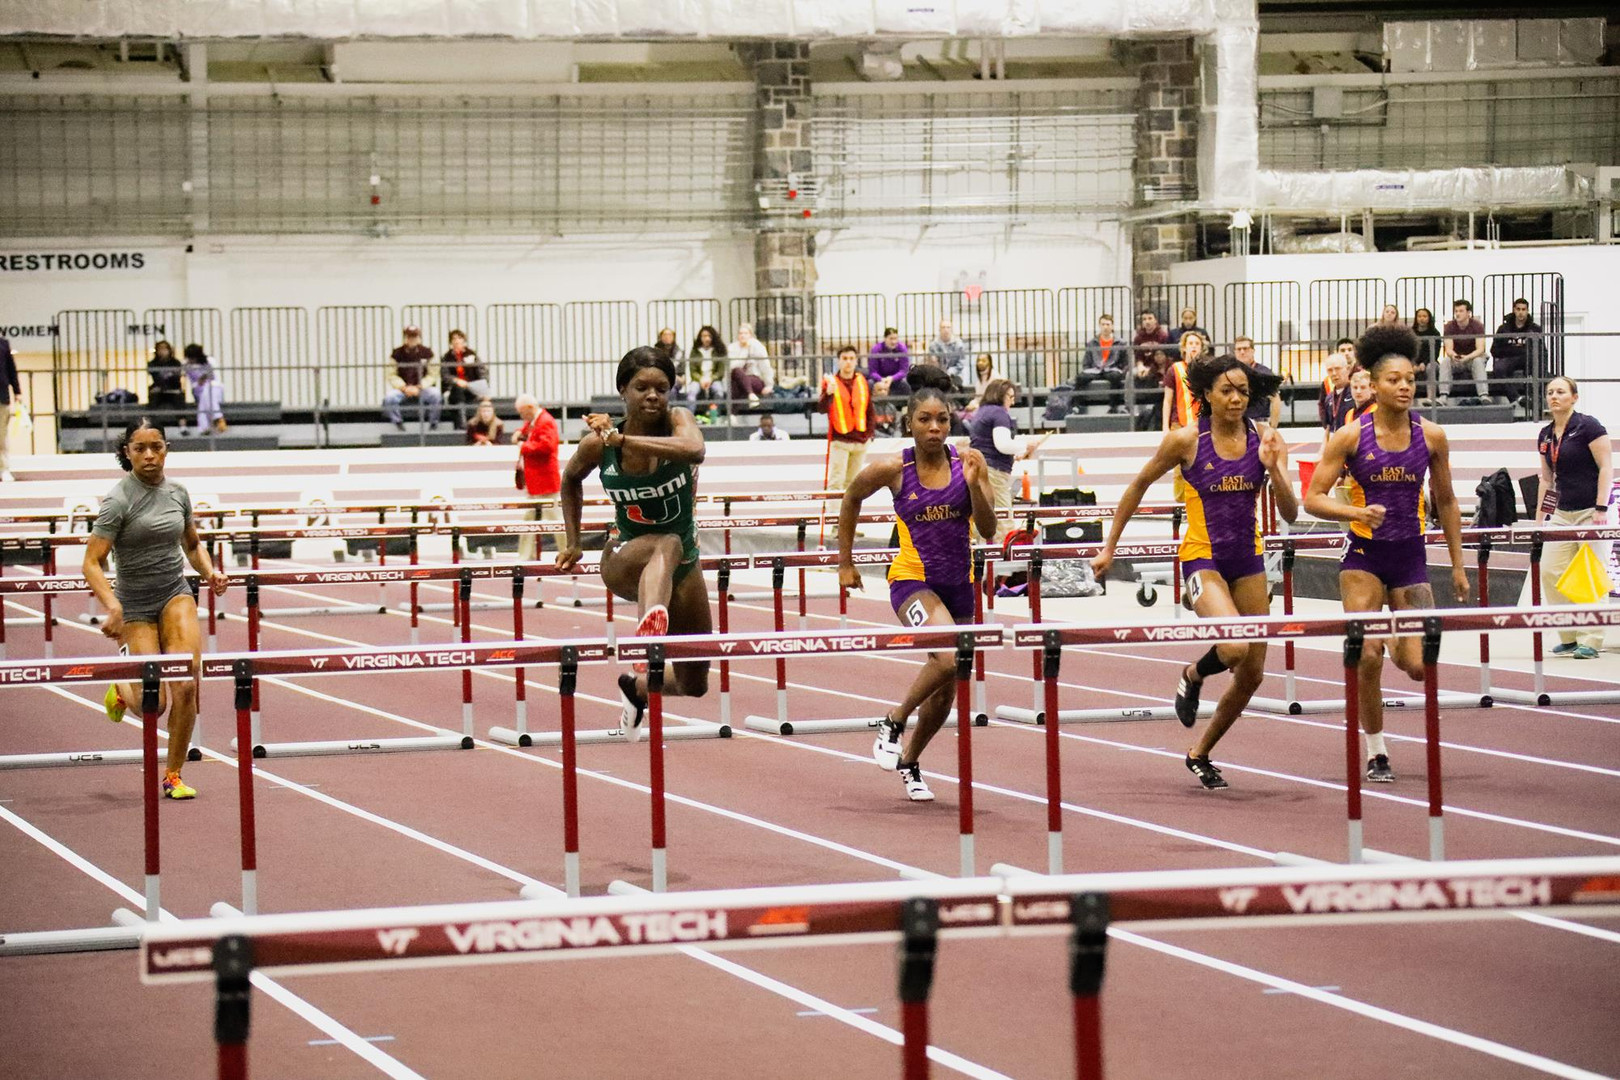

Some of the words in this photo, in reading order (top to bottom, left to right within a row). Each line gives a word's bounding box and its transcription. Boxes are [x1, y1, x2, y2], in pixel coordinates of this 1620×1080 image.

[0, 253, 145, 271] RESTROOMS
[0, 325, 60, 337] WOMEN
[128, 324, 165, 335] MEN
[1382, 466, 1406, 475] EAST
[1222, 475, 1245, 484] EAST
[1370, 474, 1417, 482] CAROLINA
[1210, 482, 1254, 492] CAROLINA
[925, 504, 951, 514] EAST
[502, 525, 540, 533] VIRGINIA
[1076, 548, 1088, 556] VT
[1146, 545, 1178, 554] TECH
[818, 555, 831, 563] VT
[852, 553, 889, 563] RGINIA
[294, 574, 308, 582] VT
[316, 572, 371, 582] VIRGINIA
[371, 570, 404, 580] TECH
[1192, 576, 1200, 597] 4
[908, 603, 924, 626] 5
[1398, 621, 1424, 629] UCS
[1492, 615, 1511, 626] VT
[1522, 612, 1598, 626] VIRGINIA
[1018, 634, 1043, 642] UCS
[1114, 629, 1131, 640] VT
[1143, 626, 1219, 640] VIRGINIA
[1220, 624, 1268, 637] TECH
[1363, 623, 1389, 631] UCS
[621, 648, 647, 656] UCS
[719, 642, 737, 653] VT
[749, 639, 825, 653] VIRGINIA
[828, 636, 876, 650] TECH
[974, 634, 999, 642] UCS
[206, 664, 233, 672] UCS
[310, 657, 329, 669] VT
[342, 654, 424, 669] VIRGINIA
[425, 651, 475, 665] TECH
[578, 648, 604, 656] UCS
[0, 668, 50, 682] TECH
[65, 666, 95, 675] ACC
[161, 665, 188, 673] UCS
[1218, 888, 1258, 913] VT
[1281, 881, 1448, 913] VIRGINIA
[1449, 877, 1552, 906] TECH
[375, 927, 420, 954] VT
[444, 917, 622, 953] VIRGINIA
[622, 910, 728, 942] TECH
